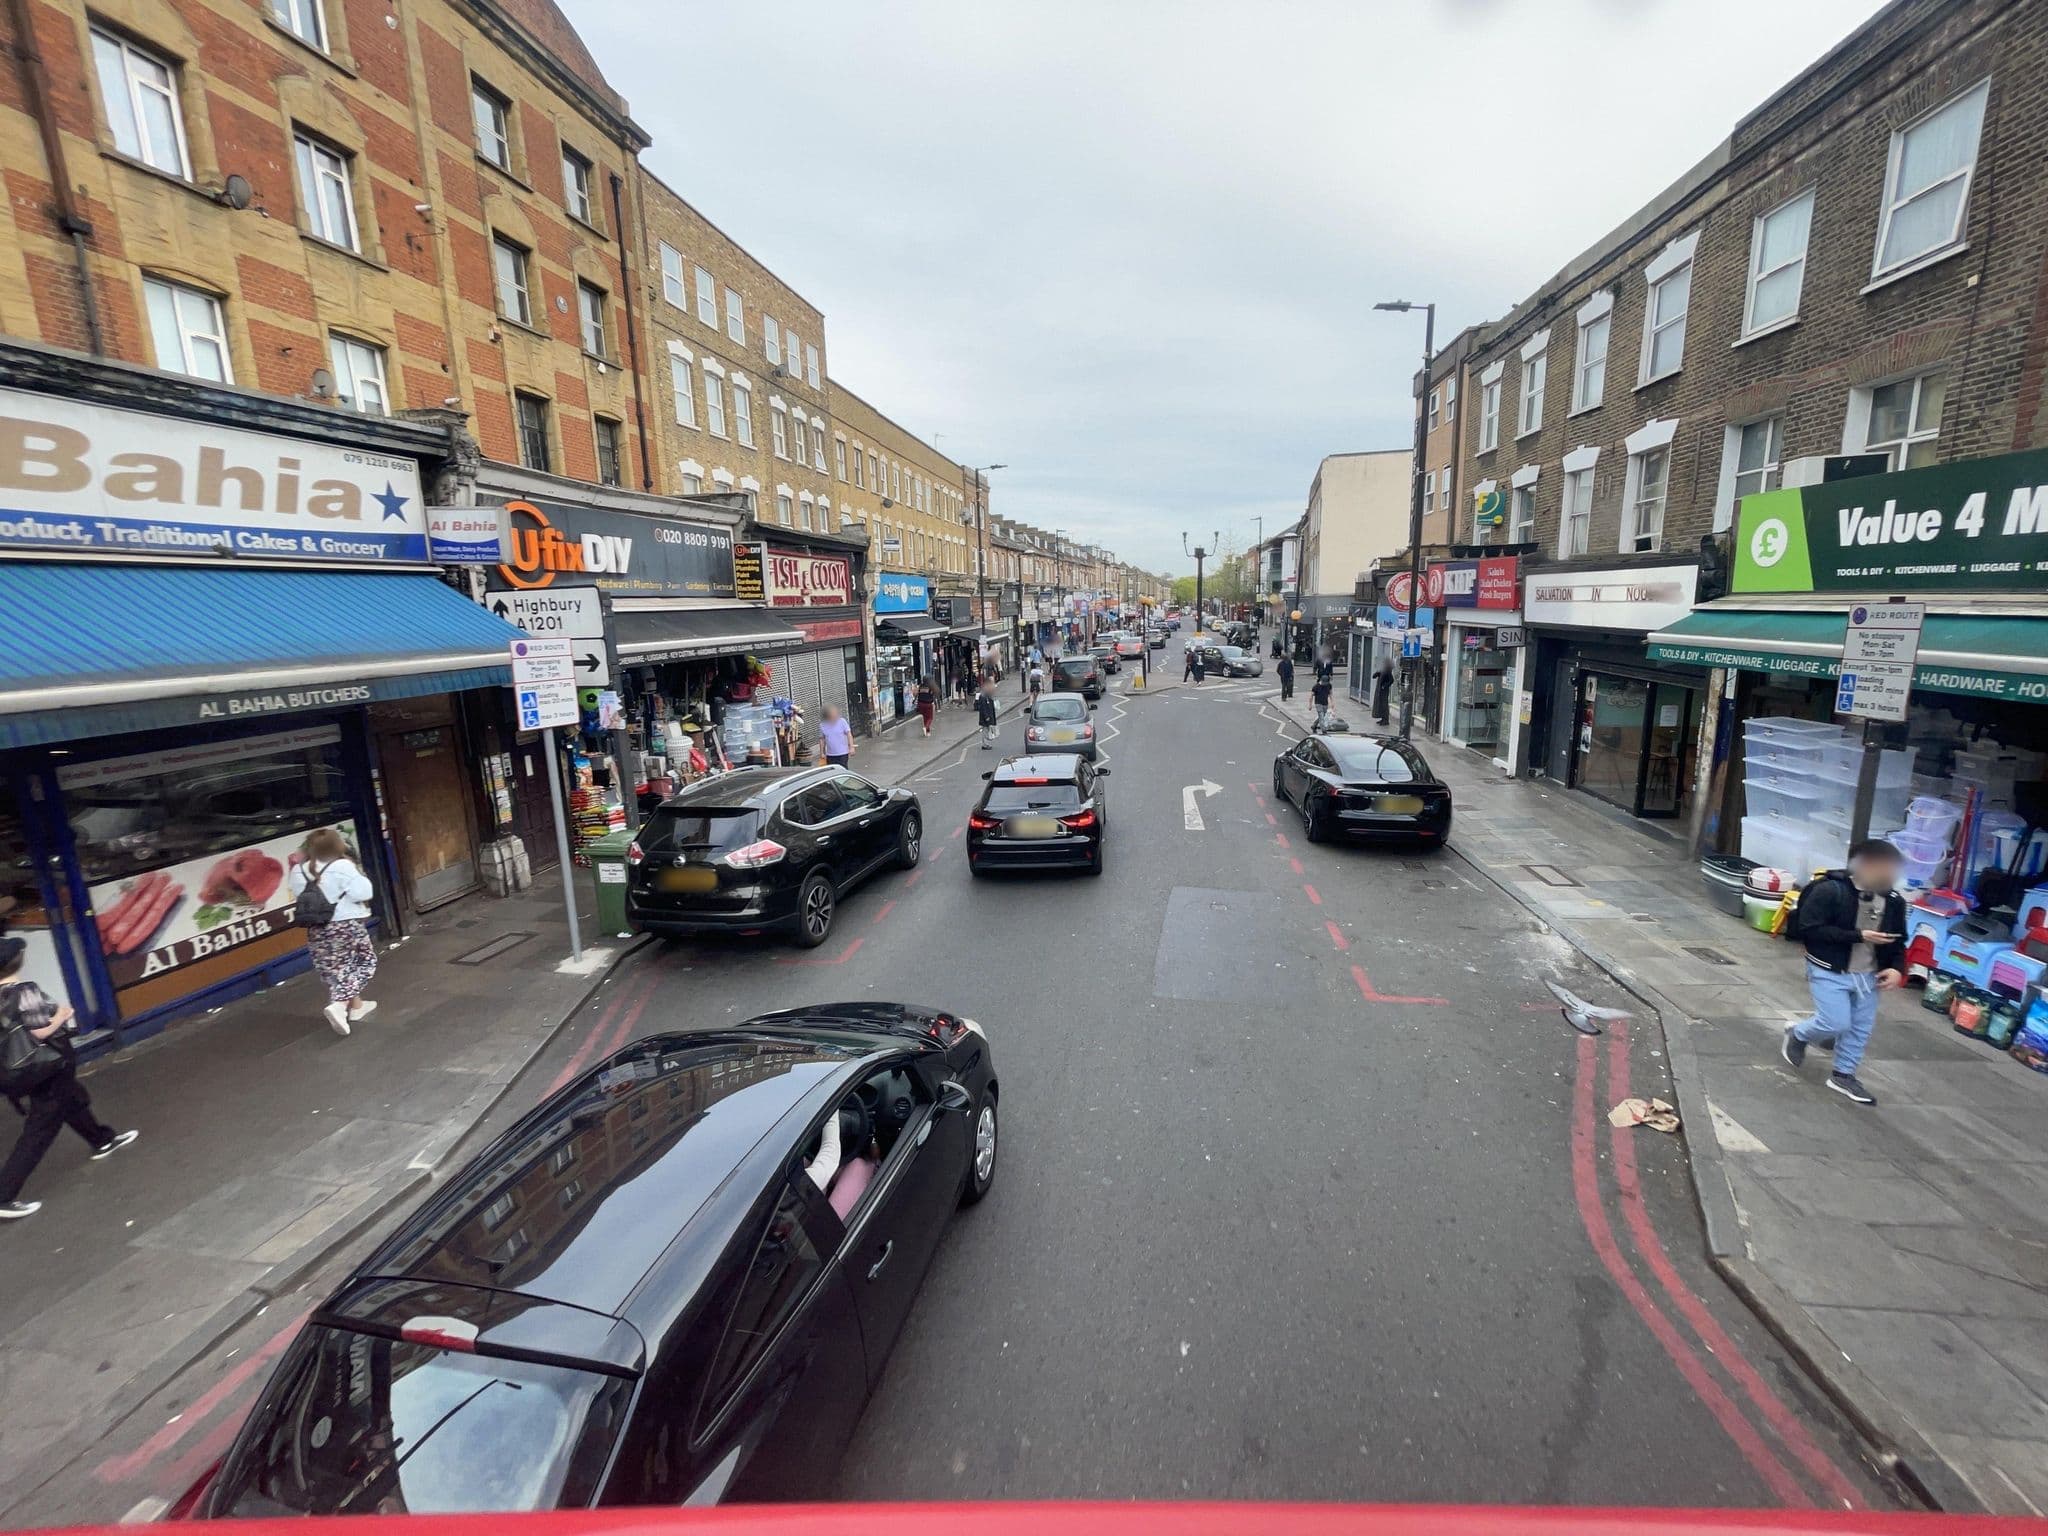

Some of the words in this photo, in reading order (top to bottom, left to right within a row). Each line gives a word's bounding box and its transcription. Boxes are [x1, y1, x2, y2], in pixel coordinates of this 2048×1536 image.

[0, 416, 362, 520] Bahia
[431, 521, 446, 531] Al
[452, 520, 497, 531] Bahia
[1839, 499, 1942, 547] Value
[1954, 492, 1987, 538] 4
[95, 522, 233, 548] Traditional
[236, 531, 297, 551] Cakes
[301, 536, 318, 552] &
[320, 537, 386, 558] Grocery
[663, 529, 681, 544] 020
[684, 531, 708, 546] 8809
[711, 536, 730, 549] 9191
[810, 559, 848, 591] COOK
[1836, 567, 1861, 578] TOOLS
[1861, 567, 1869, 577] &
[1869, 566, 1884, 577] DIY
[1894, 563, 1957, 576] KITCHENWARE
[1970, 561, 2021, 574] LUGGAGE
[1535, 586, 1573, 601] SALVATION
[1591, 586, 1601, 601] IN
[513, 598, 582, 615] Highbury
[517, 615, 563, 631] A1201
[1869, 611, 1887, 620] RED
[1889, 611, 1919, 620] ROUTE
[1501, 631, 1522, 643] SIN
[1858, 631, 1870, 639] No
[1871, 632, 1905, 641] stopping
[1658, 648, 1681, 660] TOOLS
[1686, 650, 1700, 662] DIY
[1704, 650, 1764, 668] KITCHENWARE
[1769, 658, 1819, 674] LUGGAGE
[1843, 662, 1869, 671] Except
[1857, 675, 1885, 685] loading
[1919, 671, 2007, 693] HARDWARE
[1872, 685, 1884, 693] 20
[1885, 687, 1905, 695] mins
[199, 701, 226, 718] AL
[229, 695, 288, 715] BAHIA
[287, 685, 371, 709] BUTCHERS
[1853, 701, 1868, 709] max
[1870, 702, 1876, 710] 3
[1877, 703, 1900, 713] hours
[140, 945, 180, 979] Al
[187, 918, 273, 961] Bahia
